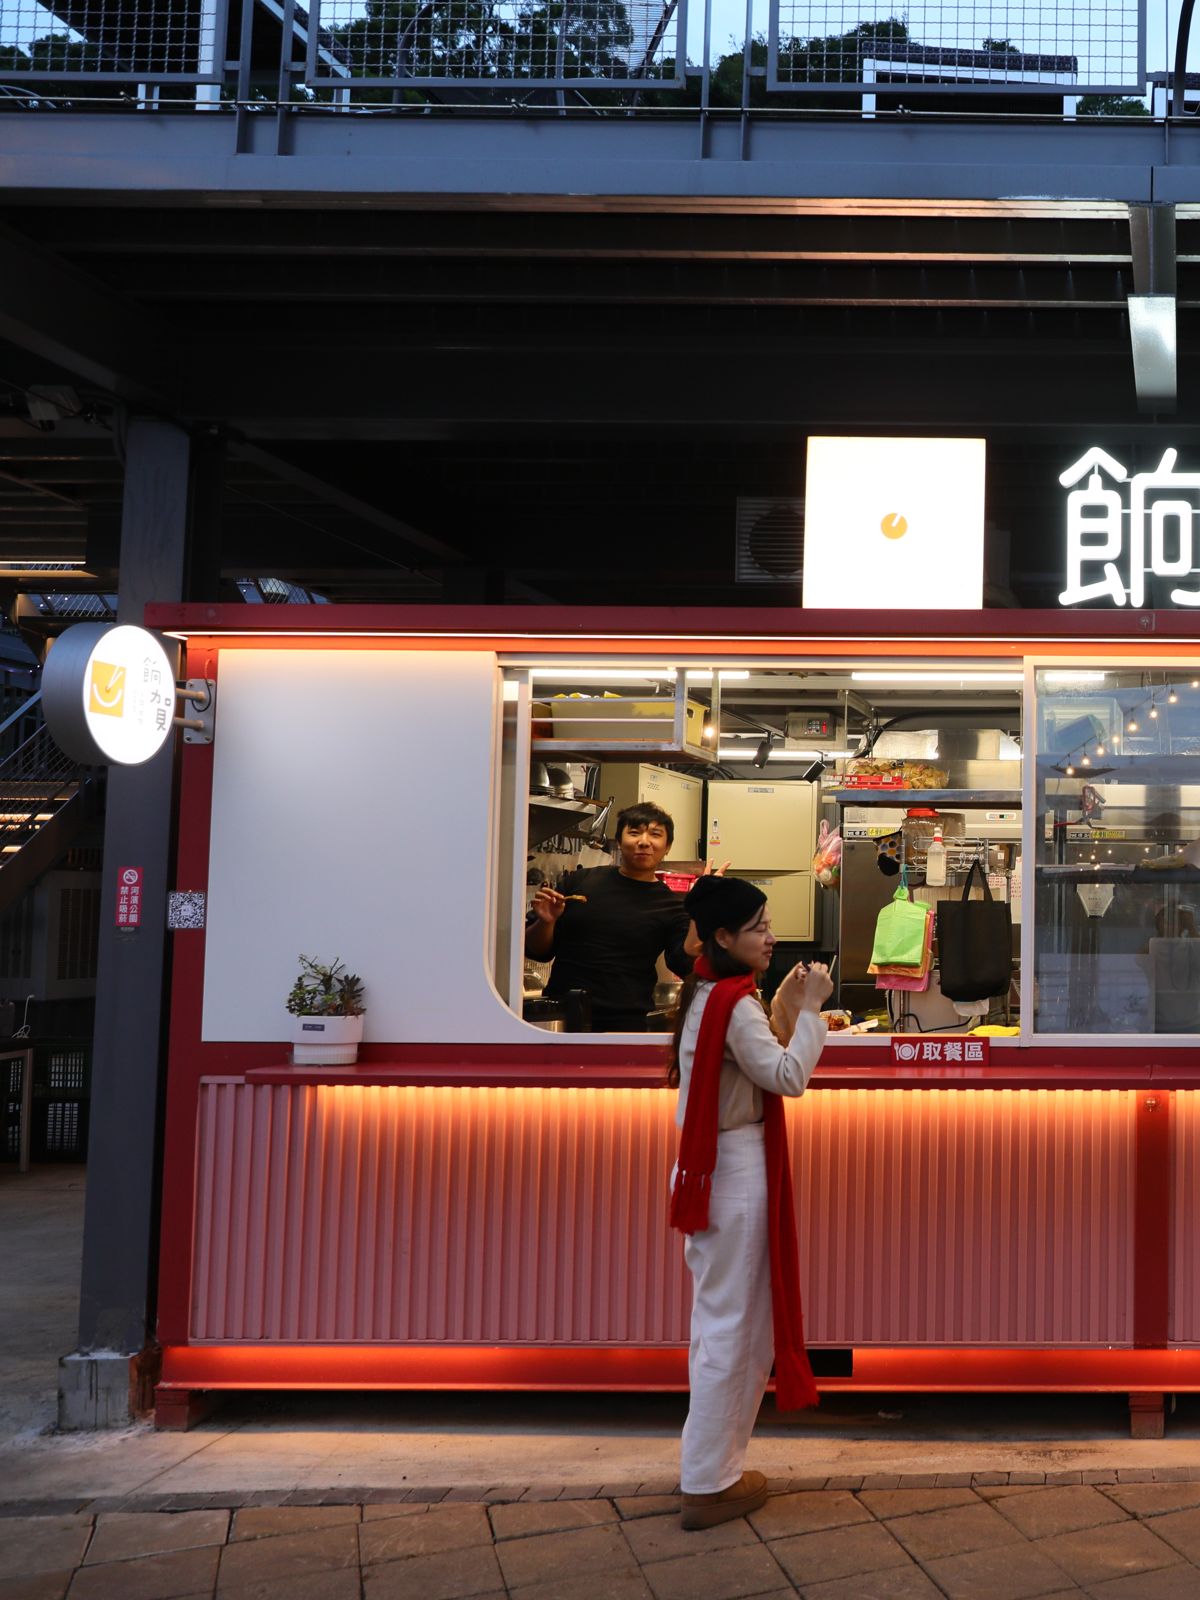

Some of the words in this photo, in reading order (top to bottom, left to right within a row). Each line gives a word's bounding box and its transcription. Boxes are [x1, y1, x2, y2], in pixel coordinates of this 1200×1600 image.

[129, 886, 140, 923] 河濱公園
[922, 1041, 983, 1062] 取餐區
